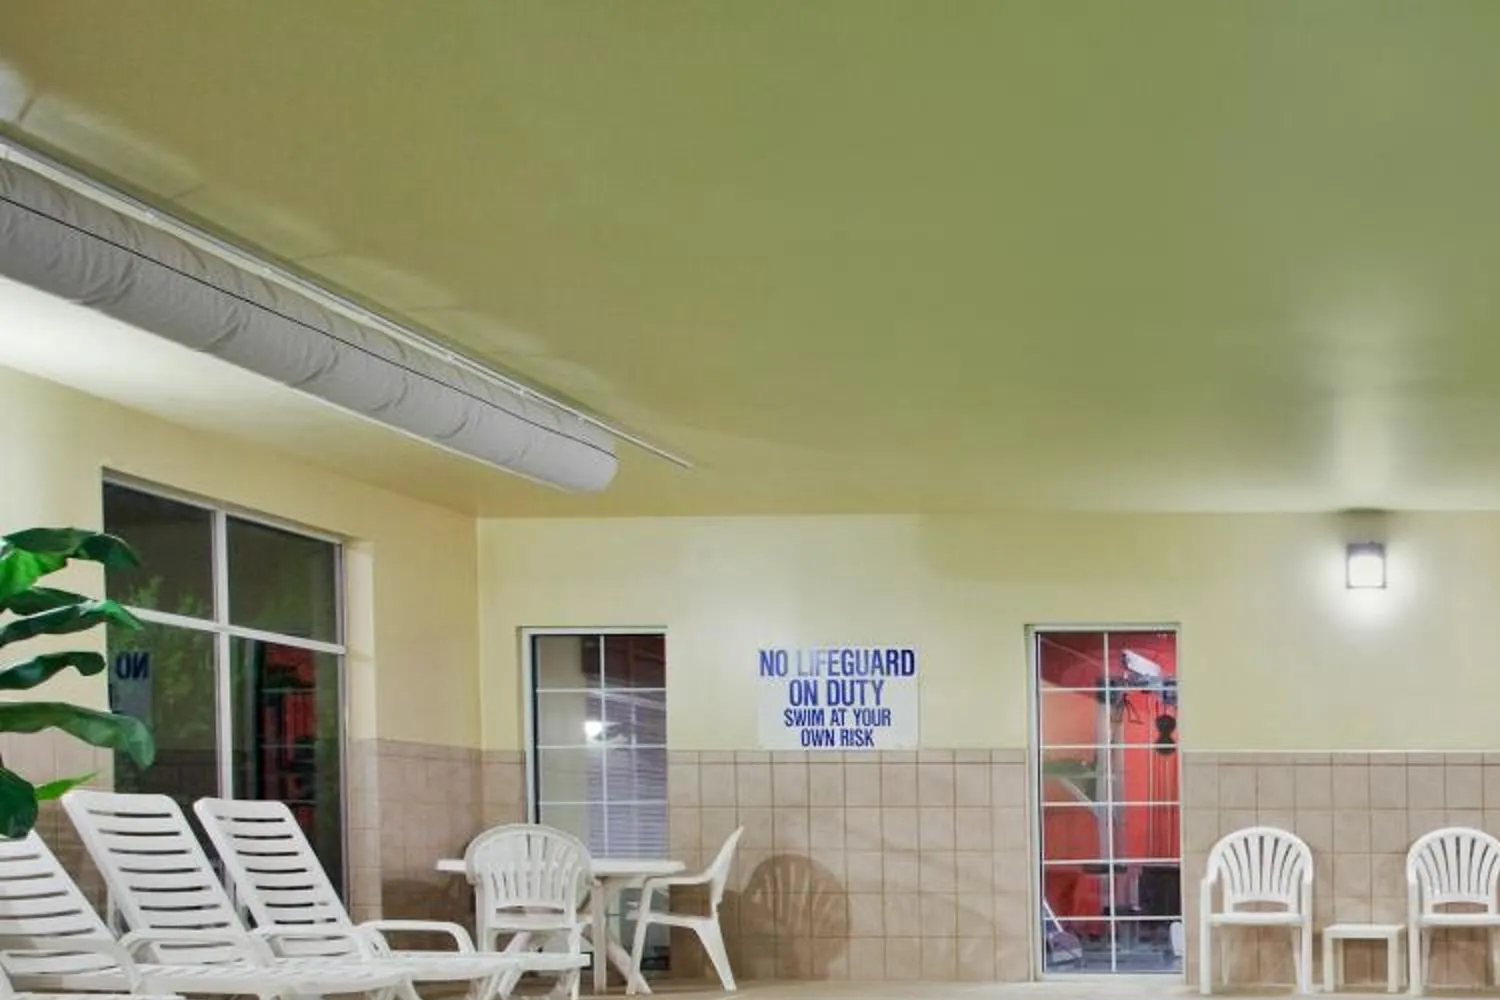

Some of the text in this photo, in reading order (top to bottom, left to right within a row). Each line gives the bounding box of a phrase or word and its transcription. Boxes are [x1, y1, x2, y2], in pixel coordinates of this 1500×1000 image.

[758, 648, 915, 677] NO LIFEGUARD
[789, 679, 884, 707] ON DUTY
[784, 708, 891, 727] SWIM AT YOUR
[801, 728, 875, 747] OWN RISK
